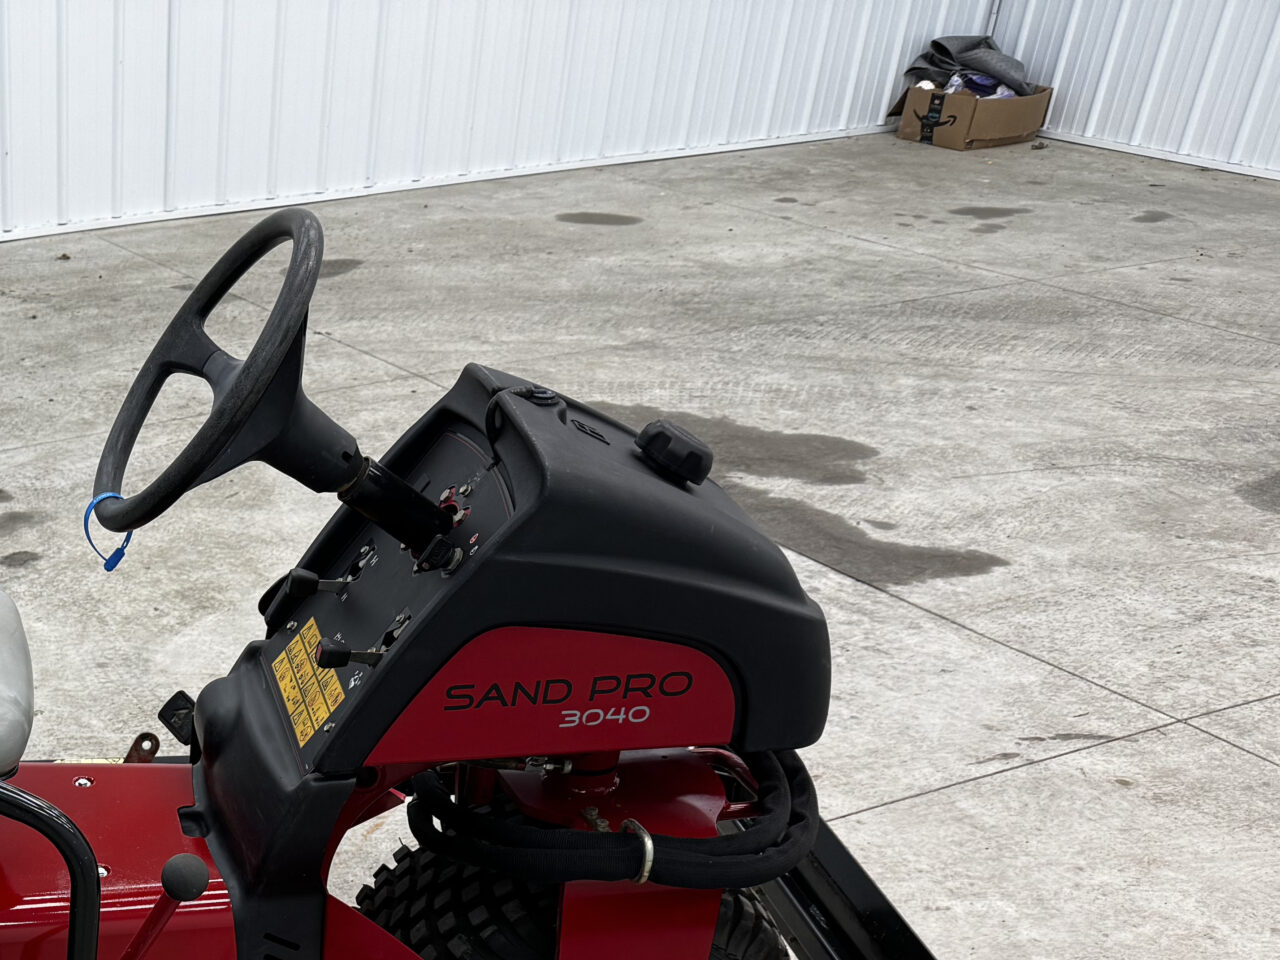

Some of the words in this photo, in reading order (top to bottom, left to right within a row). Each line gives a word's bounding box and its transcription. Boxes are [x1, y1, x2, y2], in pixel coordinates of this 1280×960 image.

[443, 679, 573, 711] SAND
[588, 671, 694, 701] PRO
[558, 705, 650, 728] 3040
